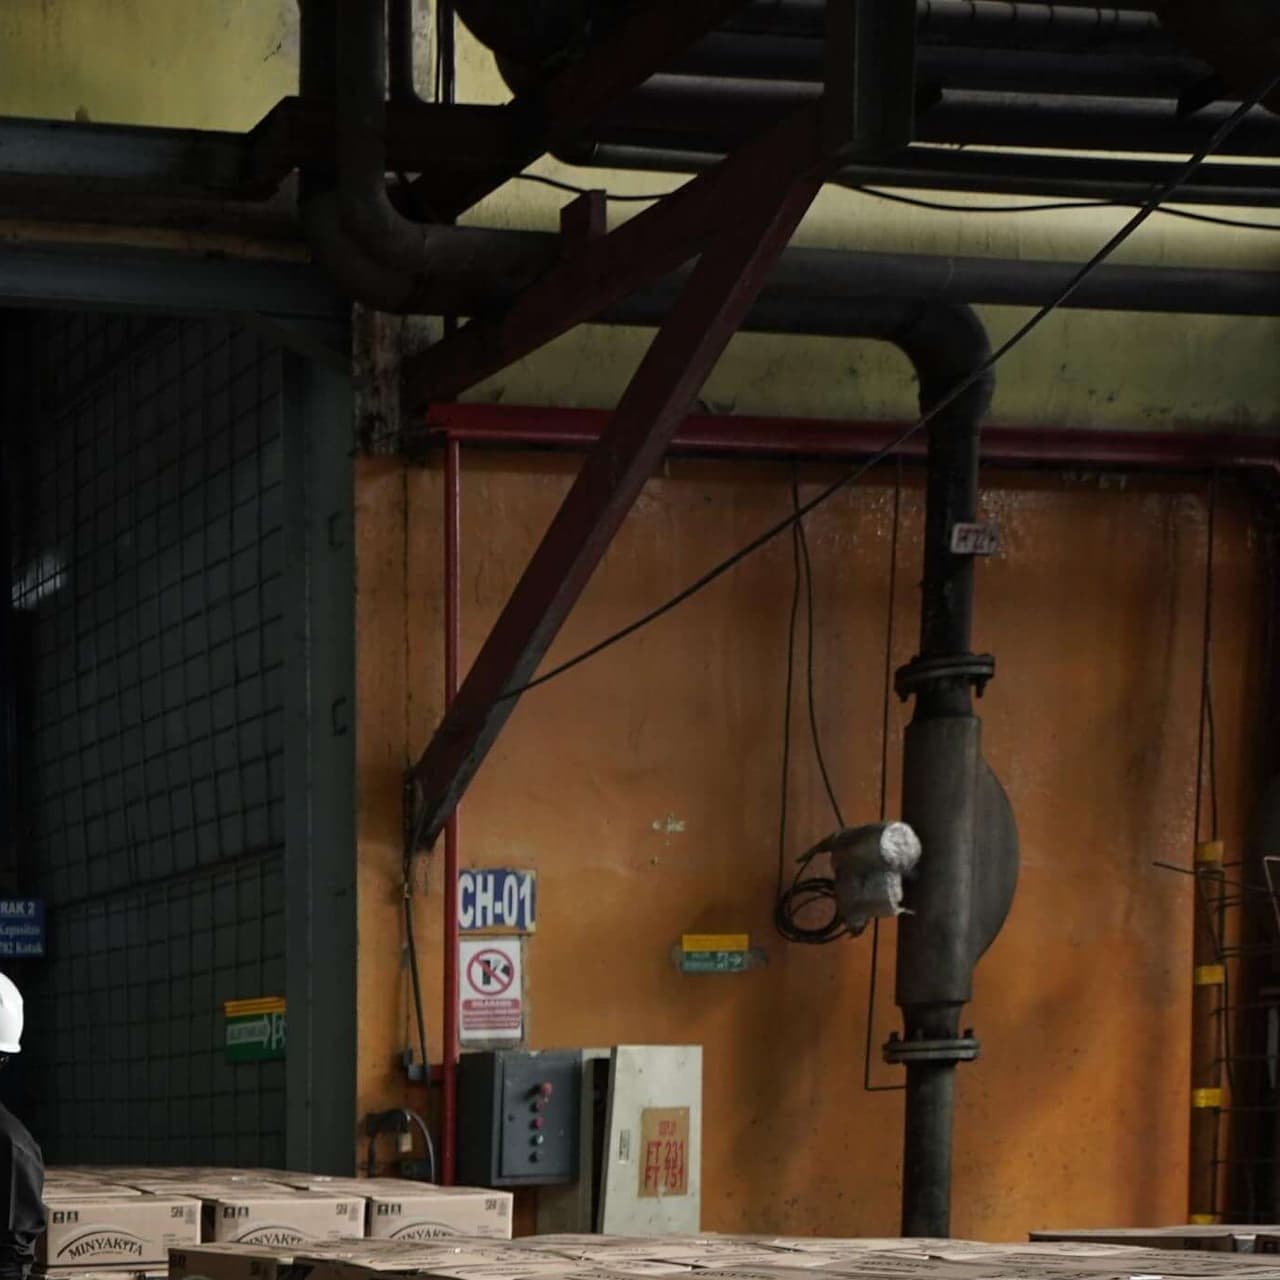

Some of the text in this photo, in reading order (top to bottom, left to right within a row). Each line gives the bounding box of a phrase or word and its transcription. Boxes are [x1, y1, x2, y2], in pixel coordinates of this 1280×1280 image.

[0, 901, 35, 913] RAK 2
[458, 873, 533, 929] CH-01
[646, 1141, 662, 1162] FT
[665, 1141, 683, 1162] 231
[645, 1166, 659, 1188] FT
[68, 1240, 143, 1260] MINYAKITA
